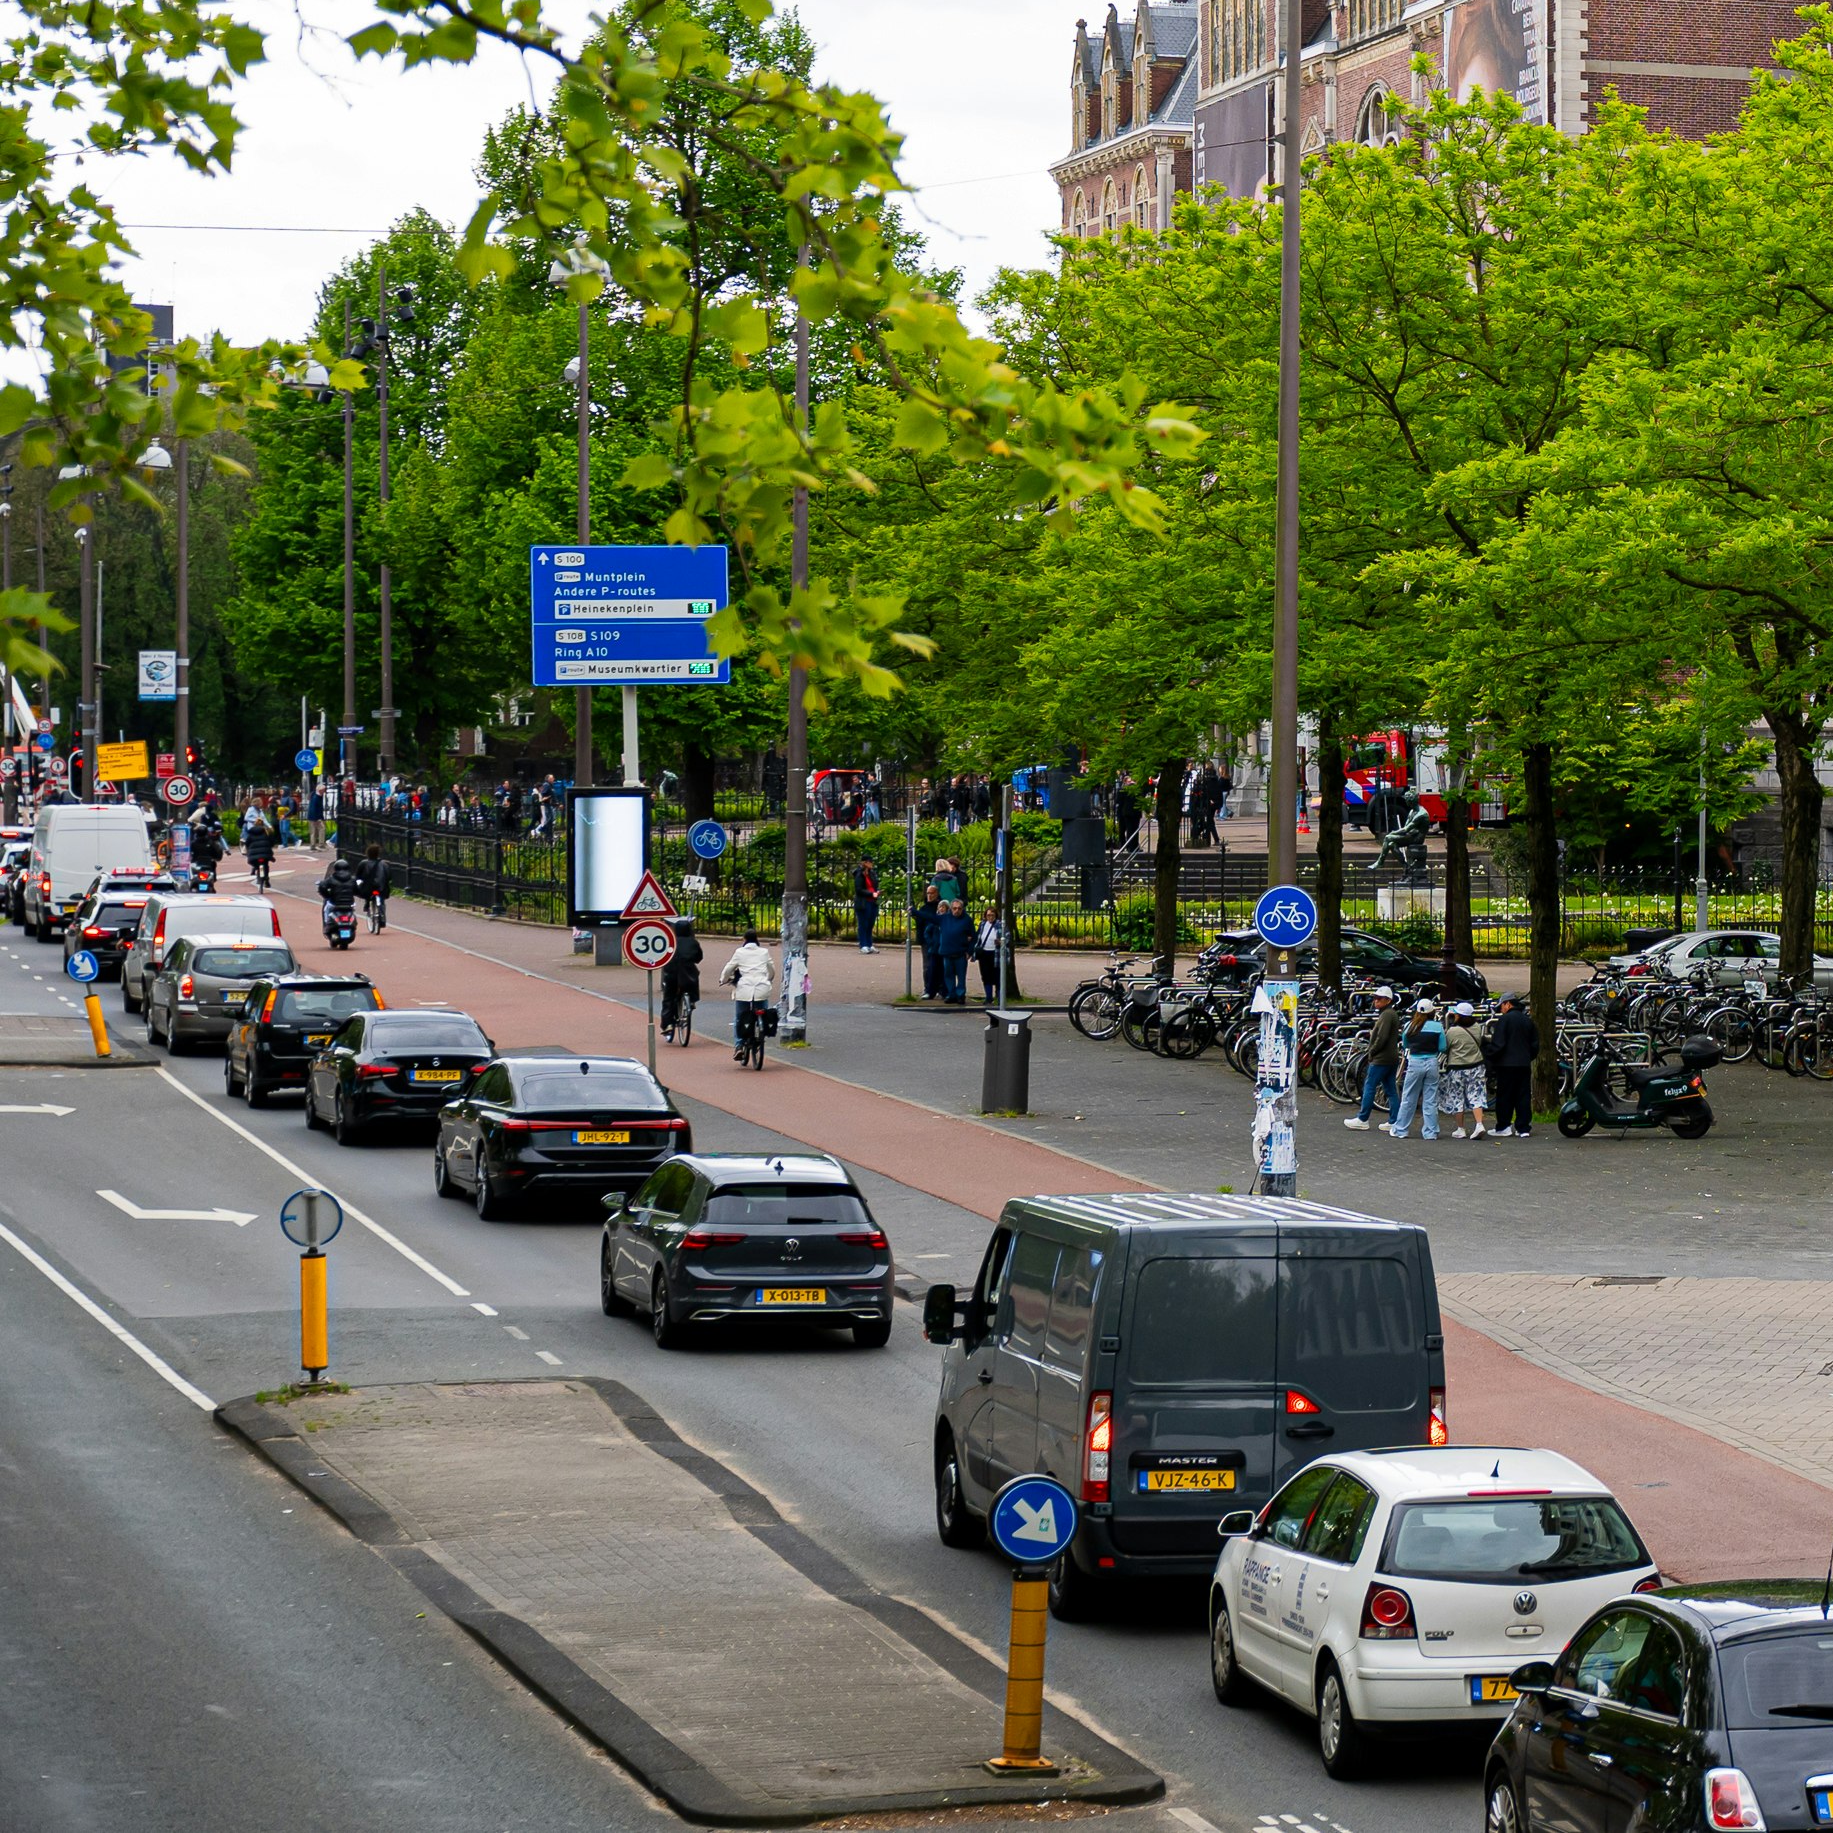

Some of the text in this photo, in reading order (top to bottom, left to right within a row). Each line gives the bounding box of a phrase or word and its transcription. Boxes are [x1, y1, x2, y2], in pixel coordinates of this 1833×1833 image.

[565, 555, 582, 564] 100
[585, 572, 646, 583] Muntplein
[554, 587, 656, 597] Andere P-routes
[573, 603, 654, 615] Heinekenplein
[567, 632, 584, 640] 108
[555, 647, 608, 659] Ring A10
[588, 664, 682, 674] Museumkwartier
[169, 784, 189, 796] 30
[634, 935, 667, 954] 30
[581, 1132, 626, 1142] JHL-92-T
[769, 1290, 820, 1302] X-013-TB
[1158, 1457, 1218, 1465] MASTER
[1155, 1472, 1227, 1488] VJZ-46-K
